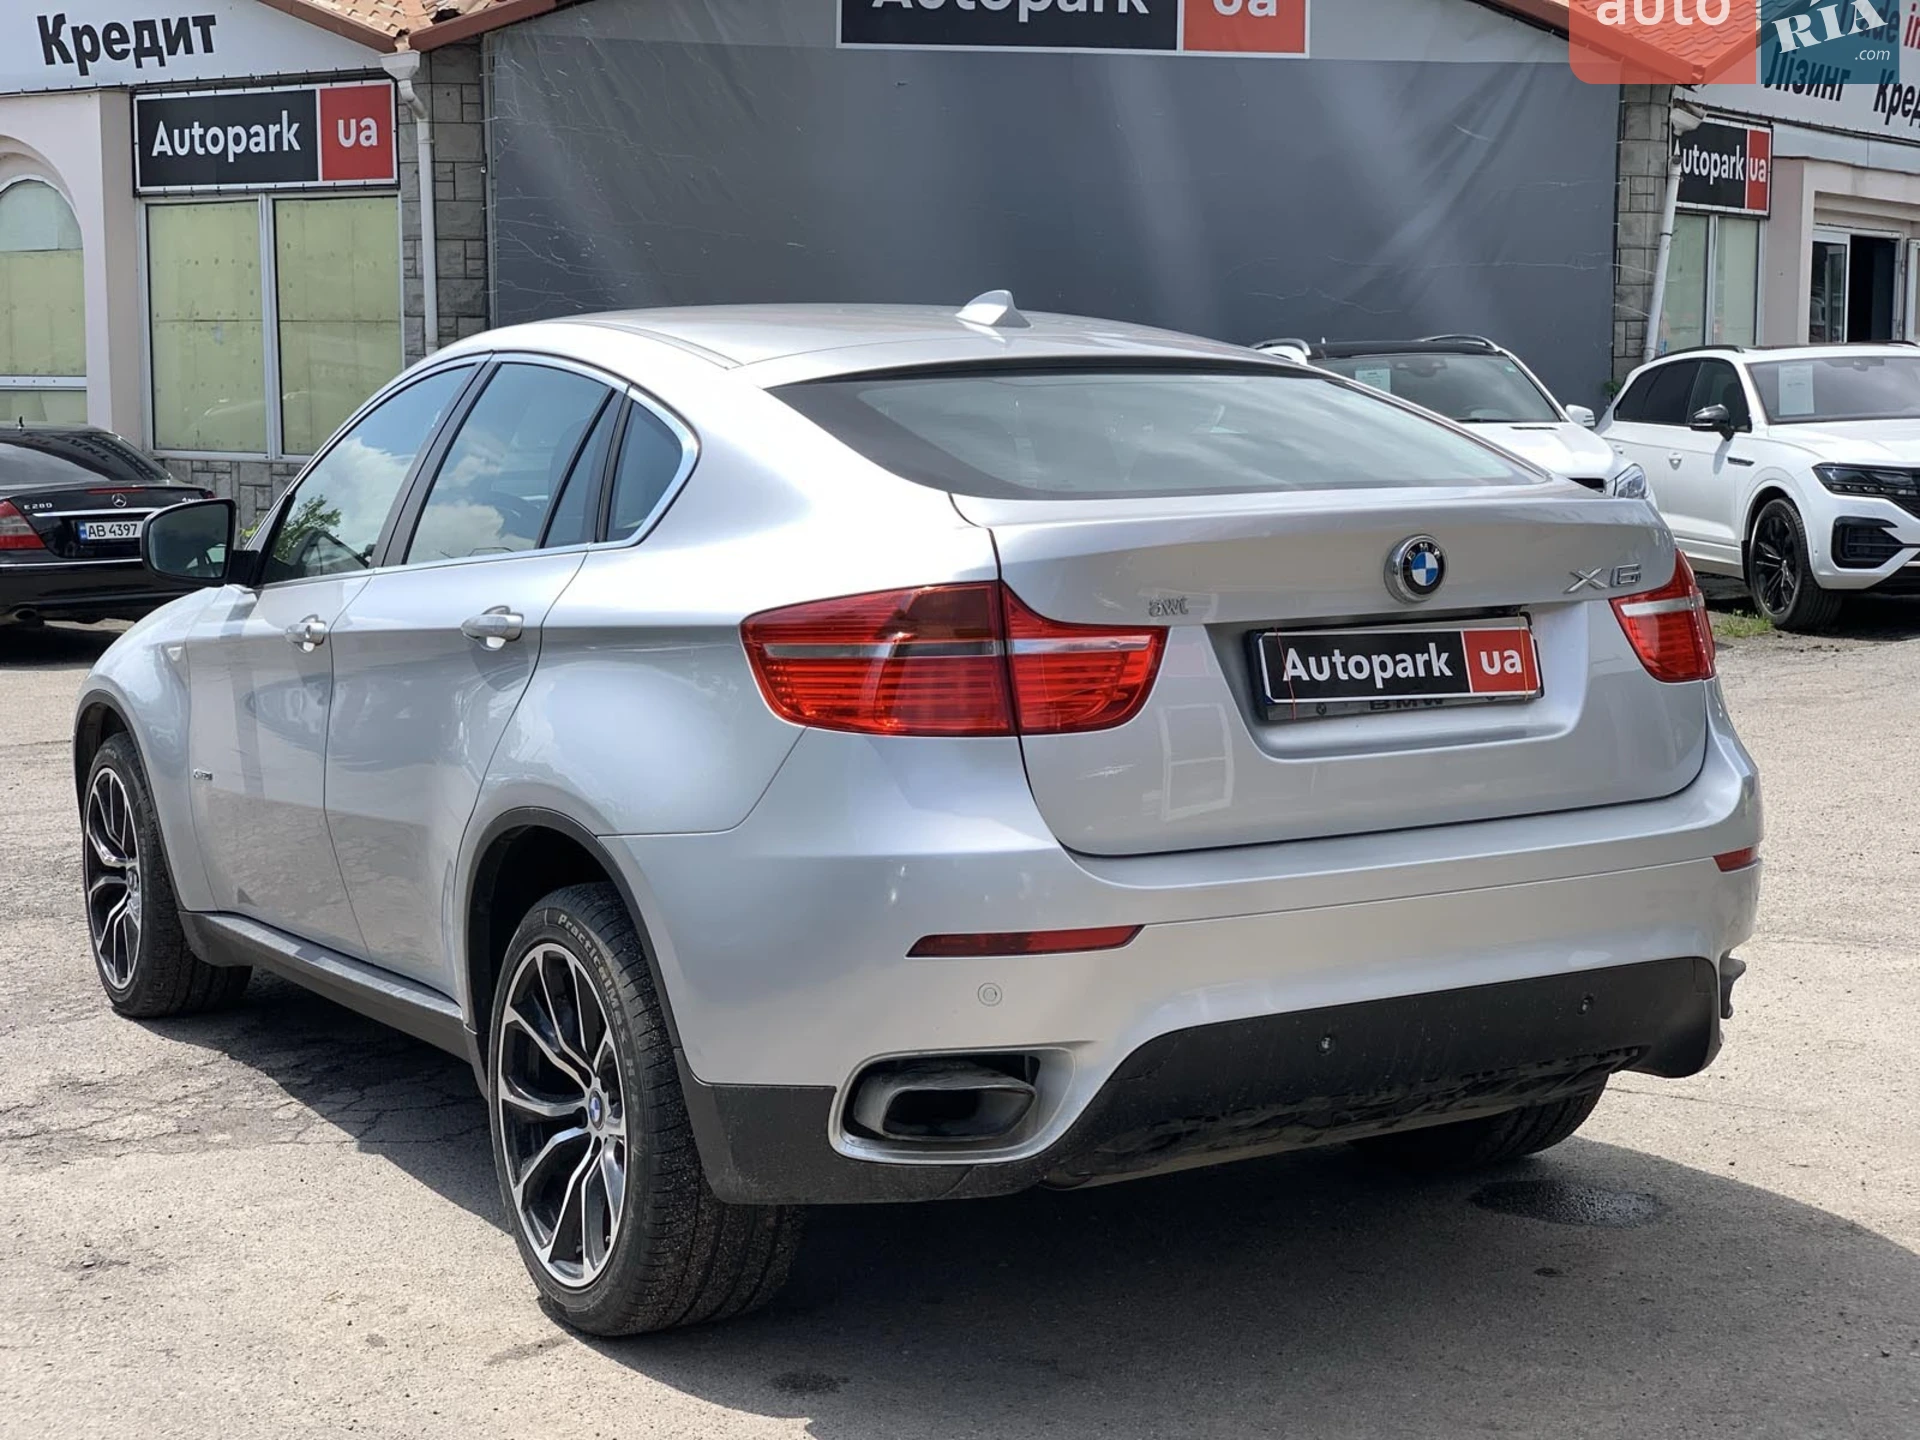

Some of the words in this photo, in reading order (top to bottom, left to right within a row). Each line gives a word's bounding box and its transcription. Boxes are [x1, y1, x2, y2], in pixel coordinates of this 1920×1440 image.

[37, 13, 216, 76] Кредит
[151, 110, 301, 163] Autopark
[337, 117, 378, 148] ua
[1749, 157, 1766, 182] ua
[88, 523, 106, 538] AB
[109, 523, 138, 537] 4397
[1283, 643, 1453, 688] Autopark
[1480, 649, 1522, 675] ua
